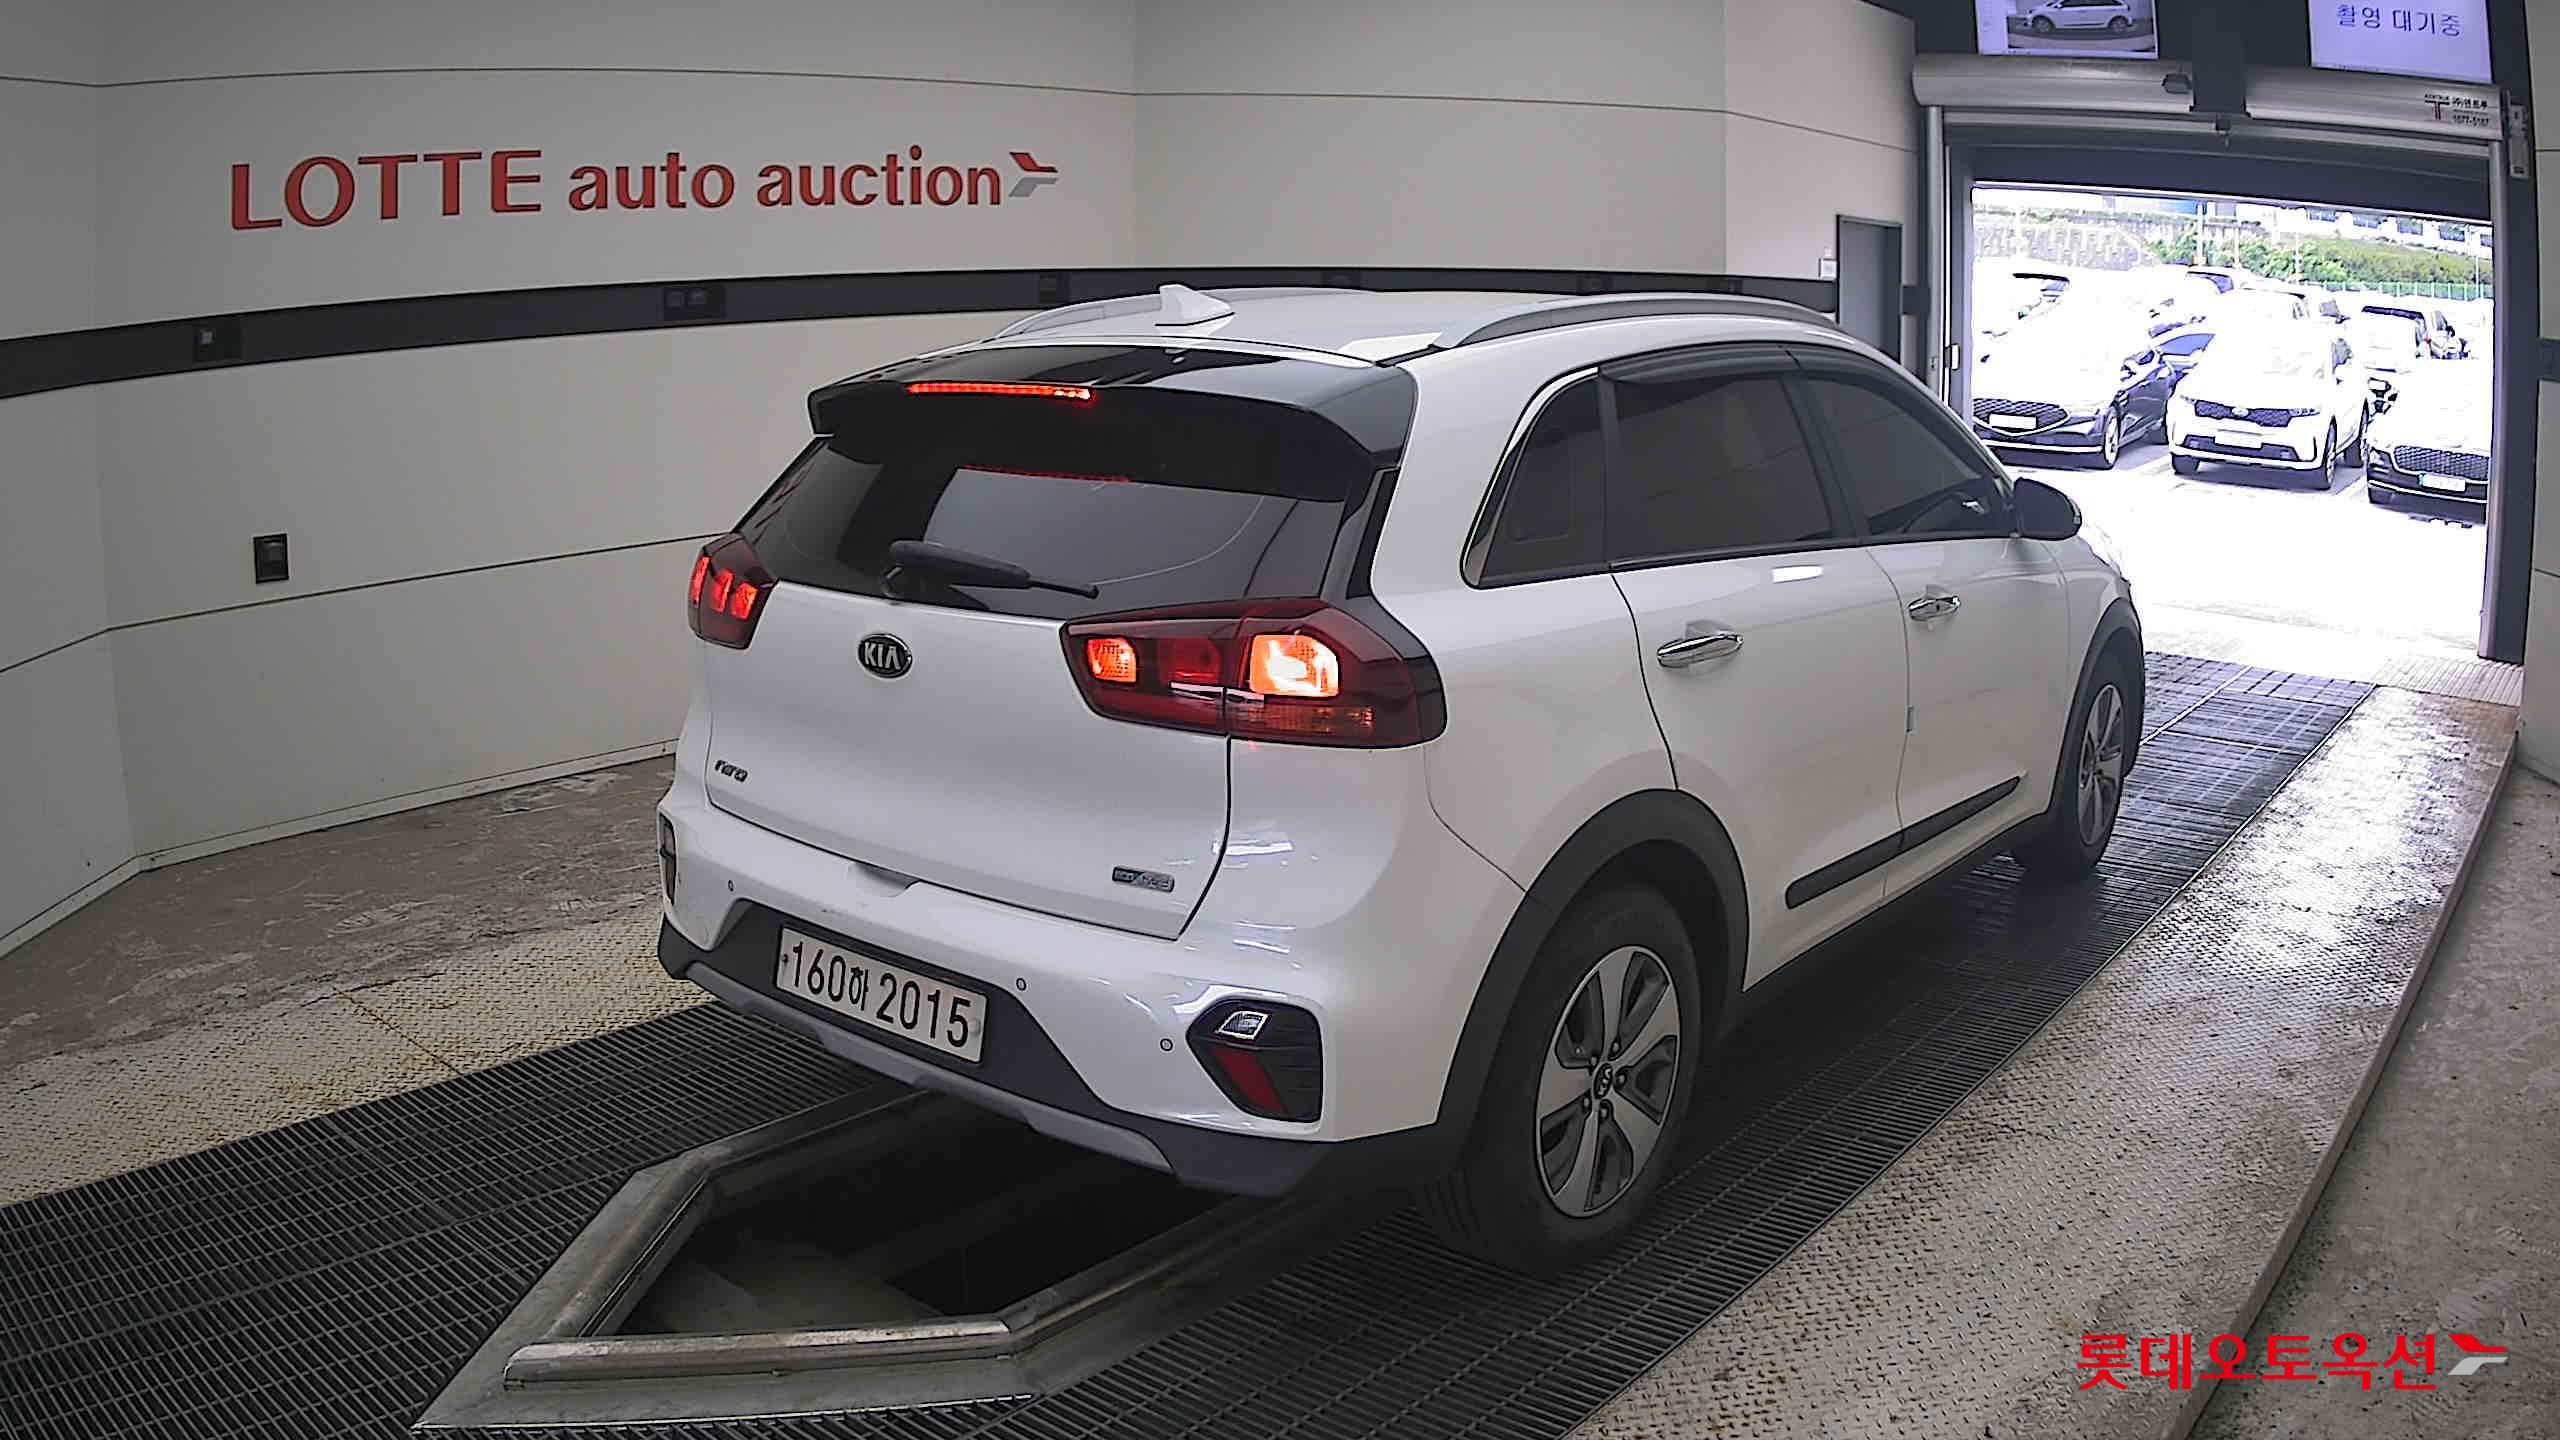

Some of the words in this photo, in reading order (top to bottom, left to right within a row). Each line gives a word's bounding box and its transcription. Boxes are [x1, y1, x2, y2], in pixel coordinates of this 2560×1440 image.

[2392, 9, 2460, 37] 대기중
[232, 149, 541, 231] LOTTE
[568, 152, 735, 210] auto
[757, 145, 1001, 206] auction
[865, 642, 901, 670] KIA
[792, 941, 870, 1012] 160하
[875, 972, 972, 1048] 2015
